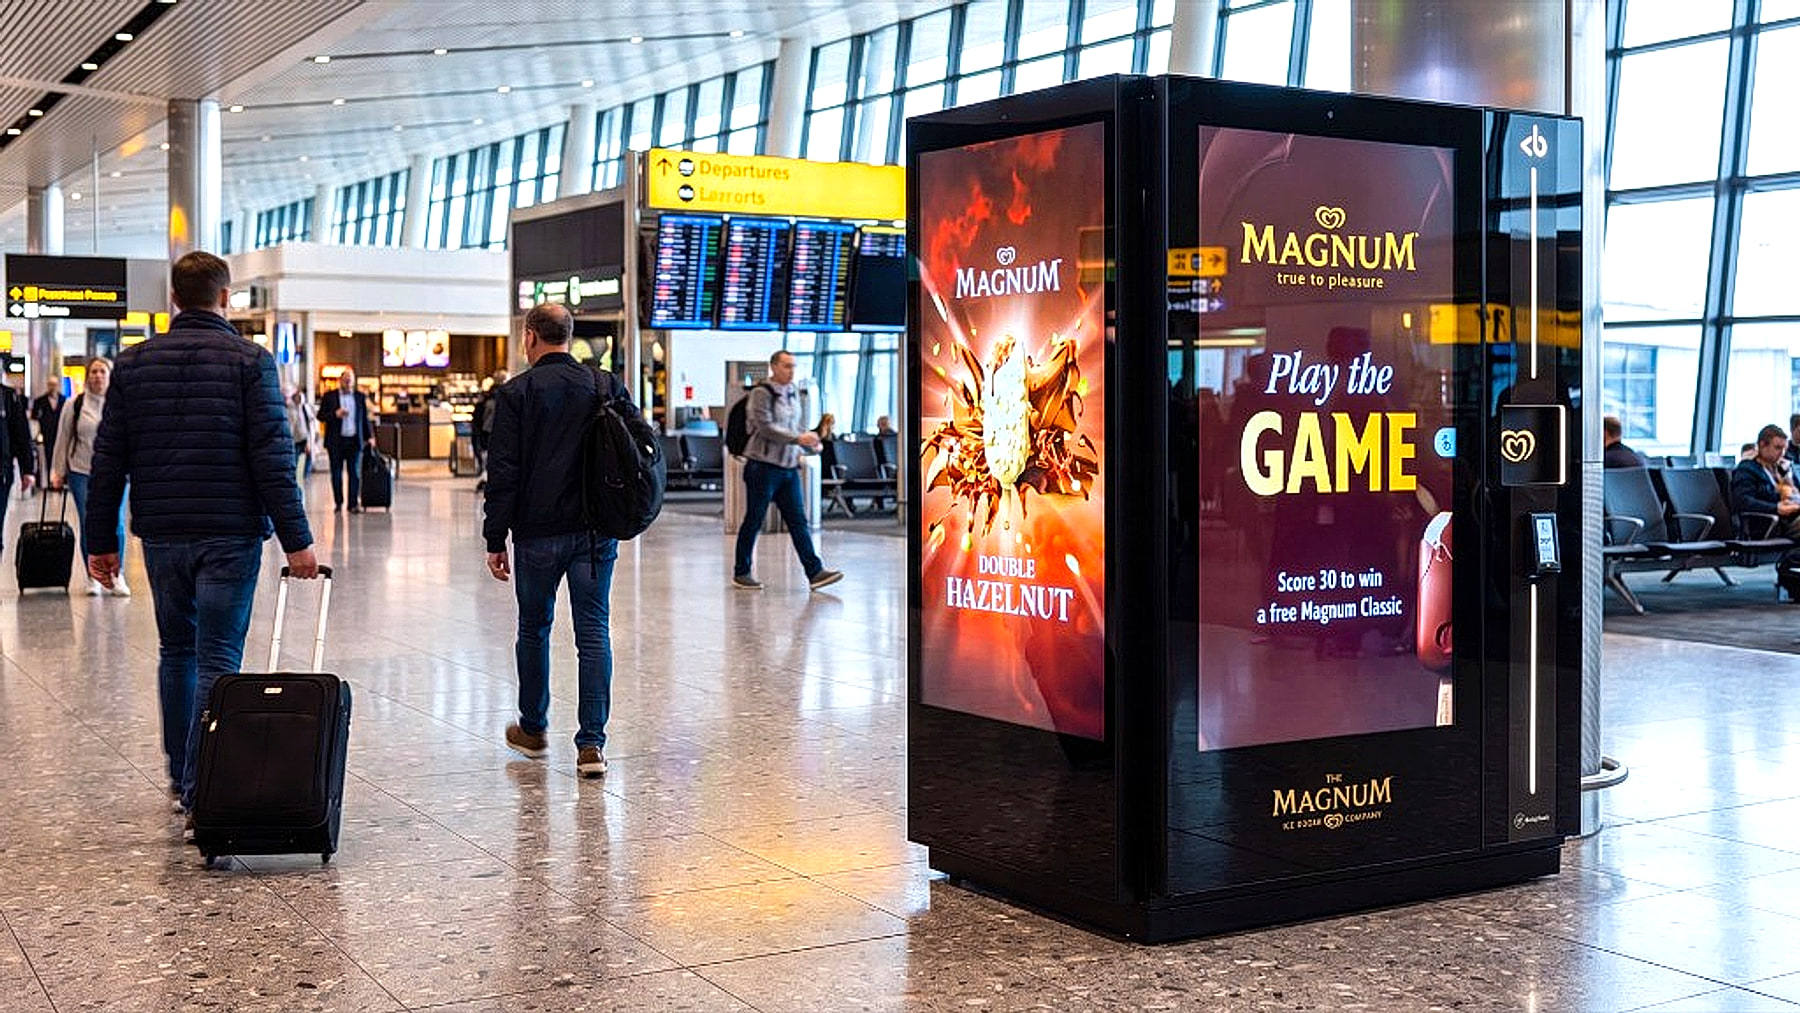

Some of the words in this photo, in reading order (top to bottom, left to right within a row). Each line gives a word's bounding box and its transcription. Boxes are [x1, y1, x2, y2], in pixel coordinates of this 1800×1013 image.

[699, 159, 790, 180] Departures
[1240, 221, 1419, 271] MAGNUM
[955, 258, 1062, 299] MAGNUM
[1276, 272, 1306, 286] true
[1310, 273, 1325, 286] to
[1328, 273, 1385, 290] pleasure
[1263, 350, 1340, 406] Play
[1347, 351, 1394, 395] the
[1240, 410, 1418, 497] GAME
[978, 555, 1036, 579] DOUBLE
[1277, 571, 1317, 593] Score
[1319, 569, 1337, 590] 30
[1340, 570, 1355, 589] to
[1358, 567, 1383, 588] win
[946, 576, 1074, 622] HAZELNUT
[1256, 608, 1267, 624] a
[1269, 602, 1297, 623] free
[1301, 600, 1357, 625] Magnum
[1360, 595, 1403, 617] Classic
[1325, 773, 1342, 784] THE
[1272, 776, 1392, 817] MAGNUM
